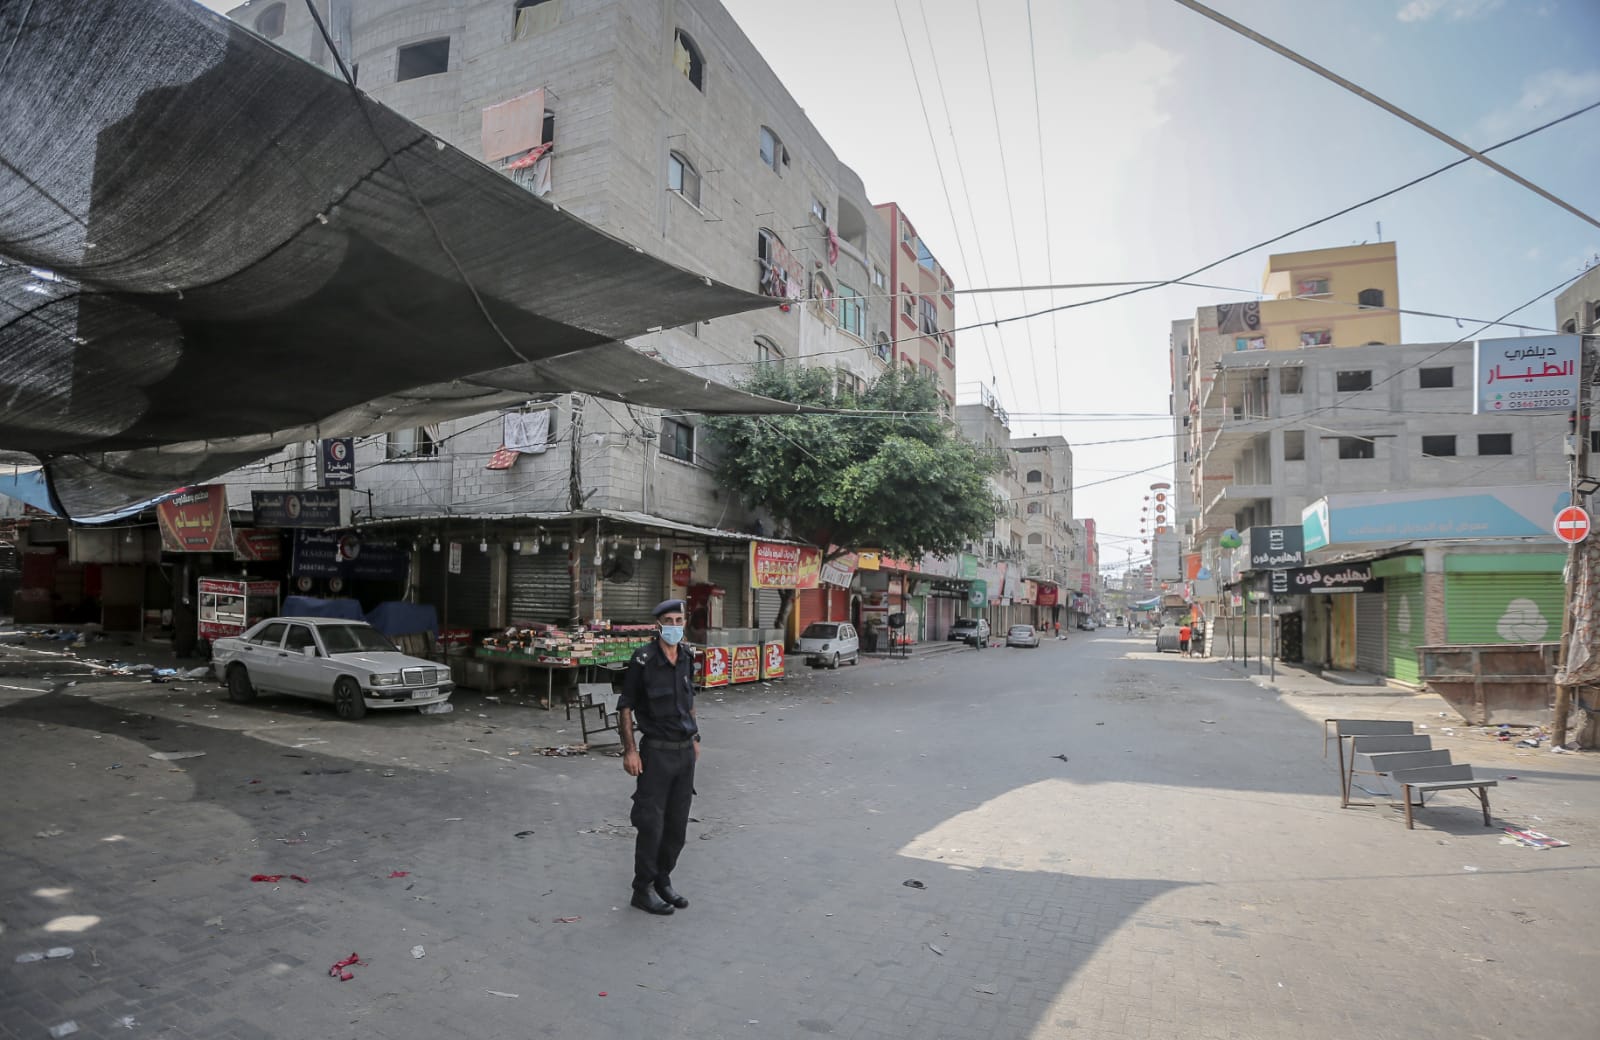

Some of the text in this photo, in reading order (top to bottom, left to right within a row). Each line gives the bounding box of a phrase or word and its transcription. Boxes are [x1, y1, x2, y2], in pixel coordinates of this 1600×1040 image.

[1503, 345, 1558, 361] ديلفري
[1486, 359, 1575, 385] الطيار
[1295, 570, 1321, 585] فون
